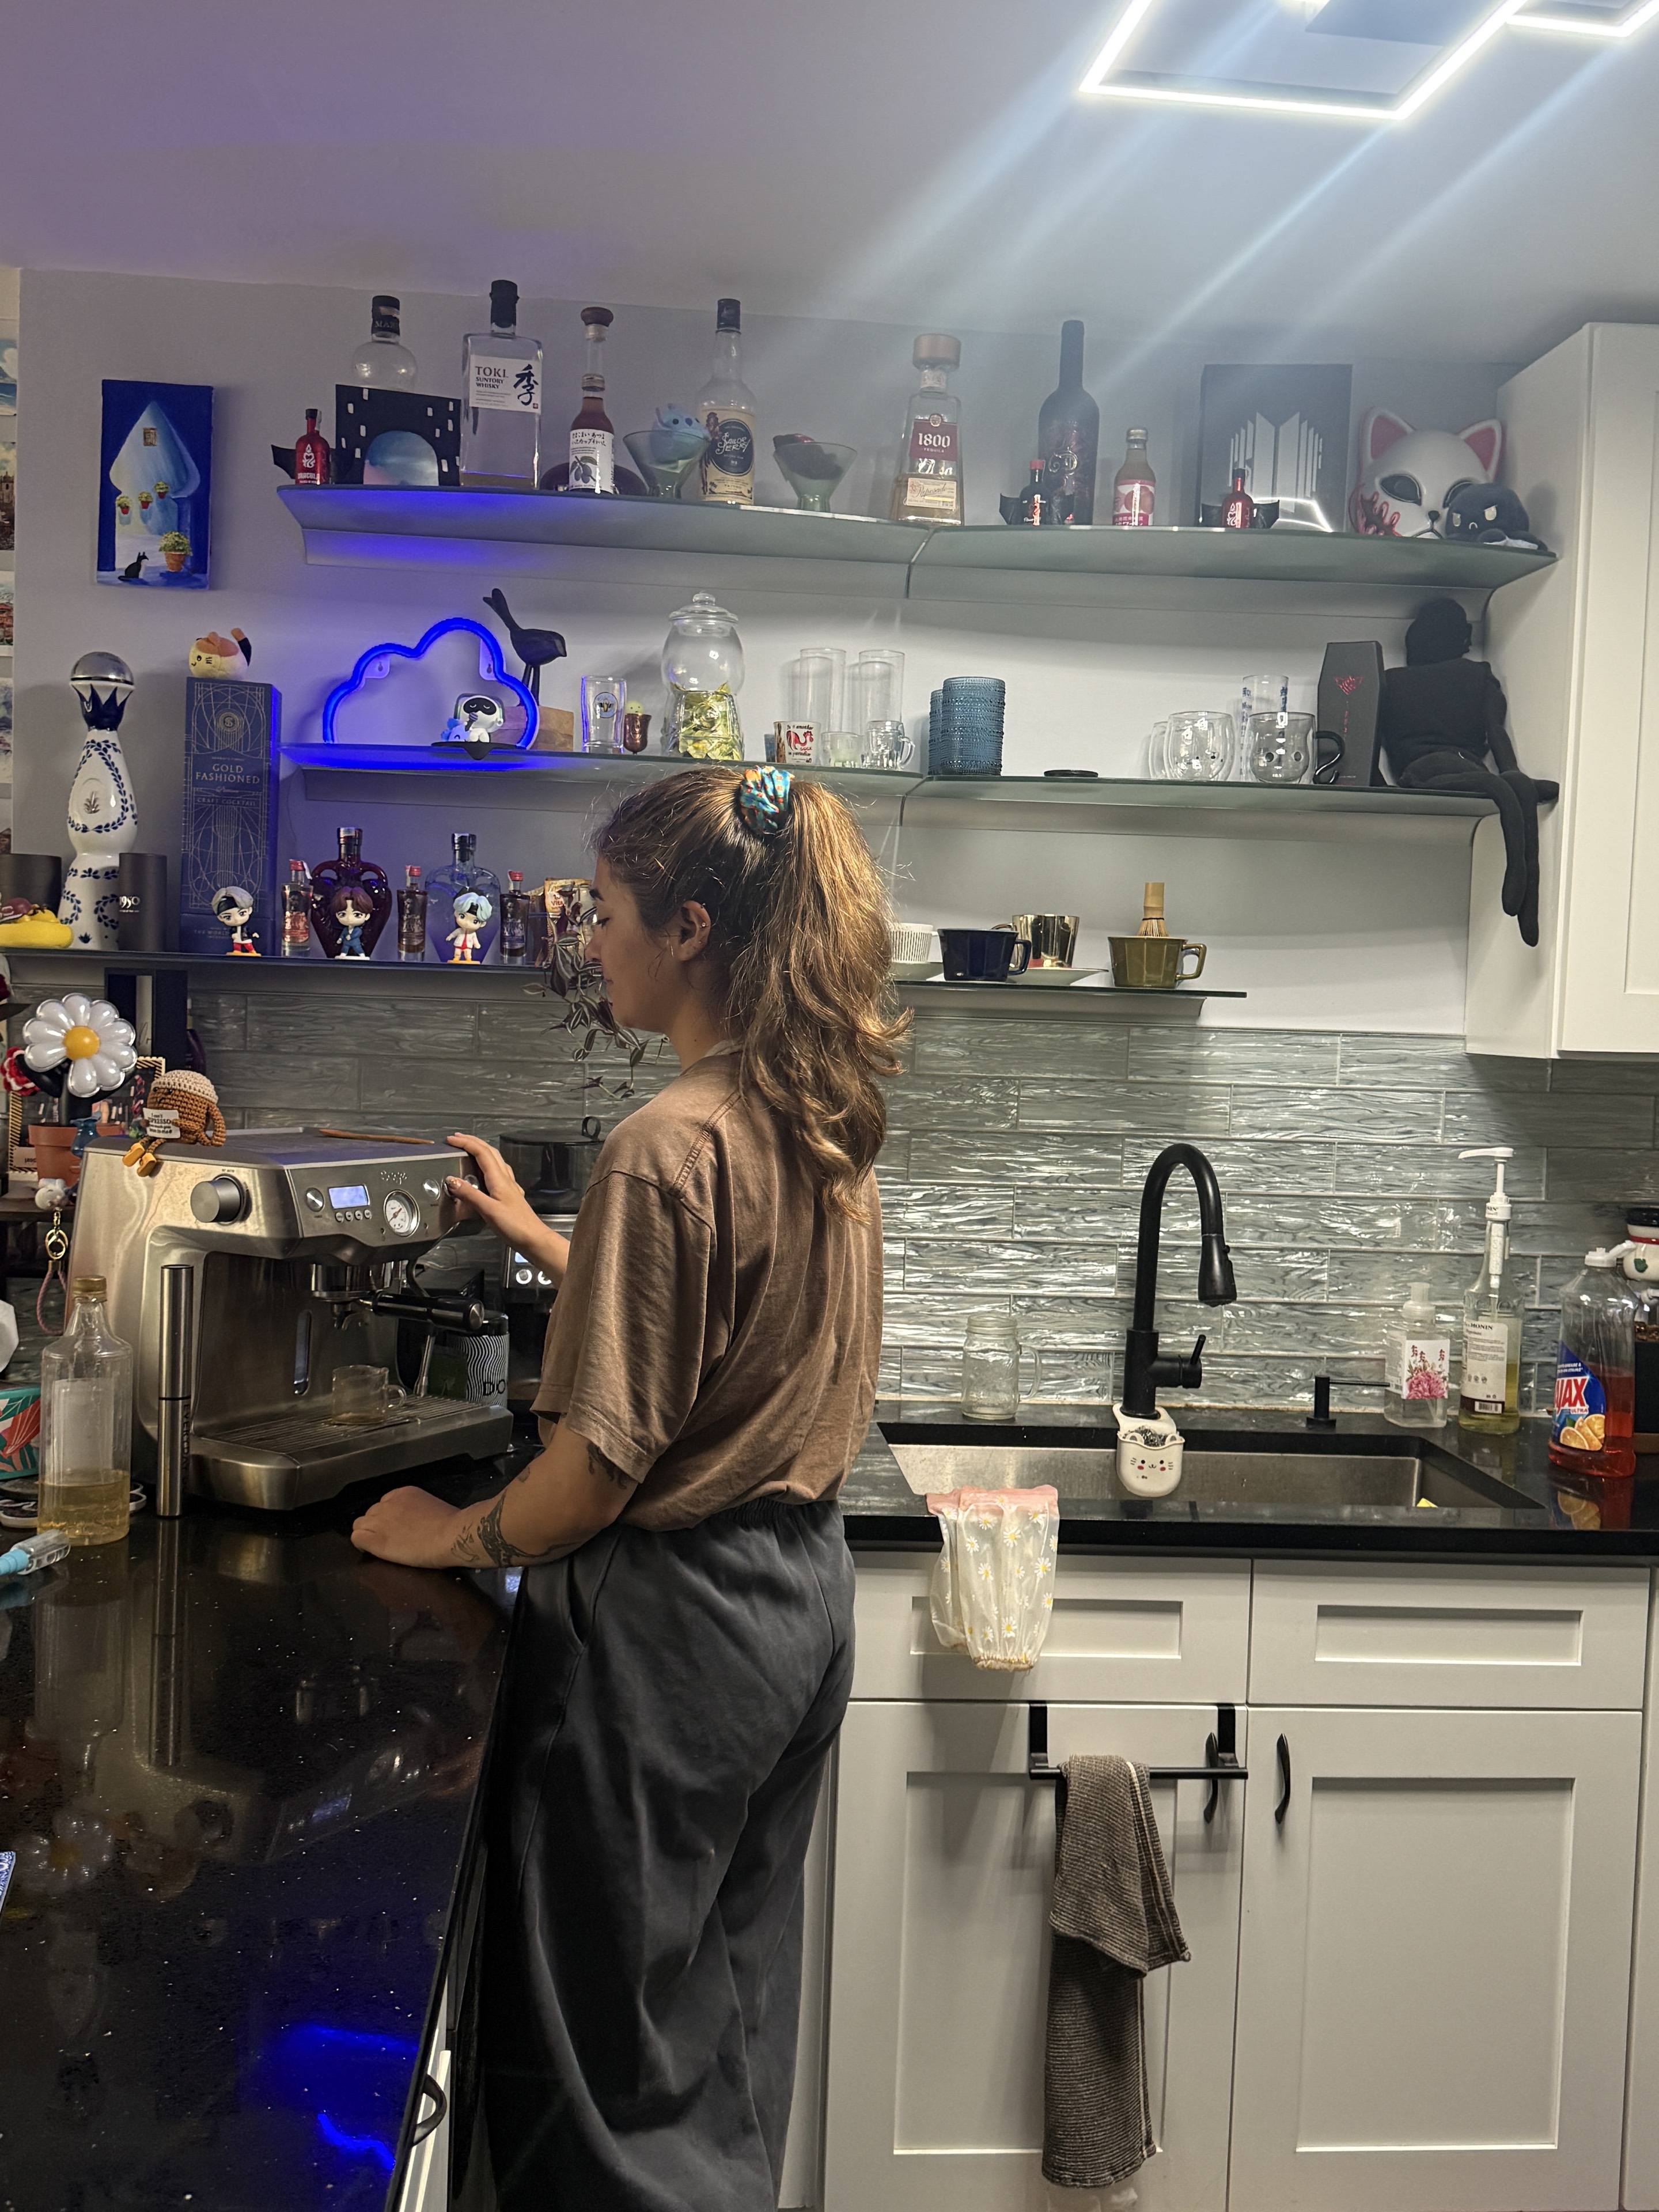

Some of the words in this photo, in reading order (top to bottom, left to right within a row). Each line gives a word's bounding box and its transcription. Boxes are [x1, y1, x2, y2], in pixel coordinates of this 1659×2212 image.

[476, 376, 503, 384] SUNTORY
[513, 363, 539, 406] 季
[918, 433, 950, 448] 1800
[715, 441, 751, 454] JERRY
[213, 763, 243, 773] GOLD
[196, 772, 260, 784] FASHIONED
[119, 896, 141, 908] 1950
